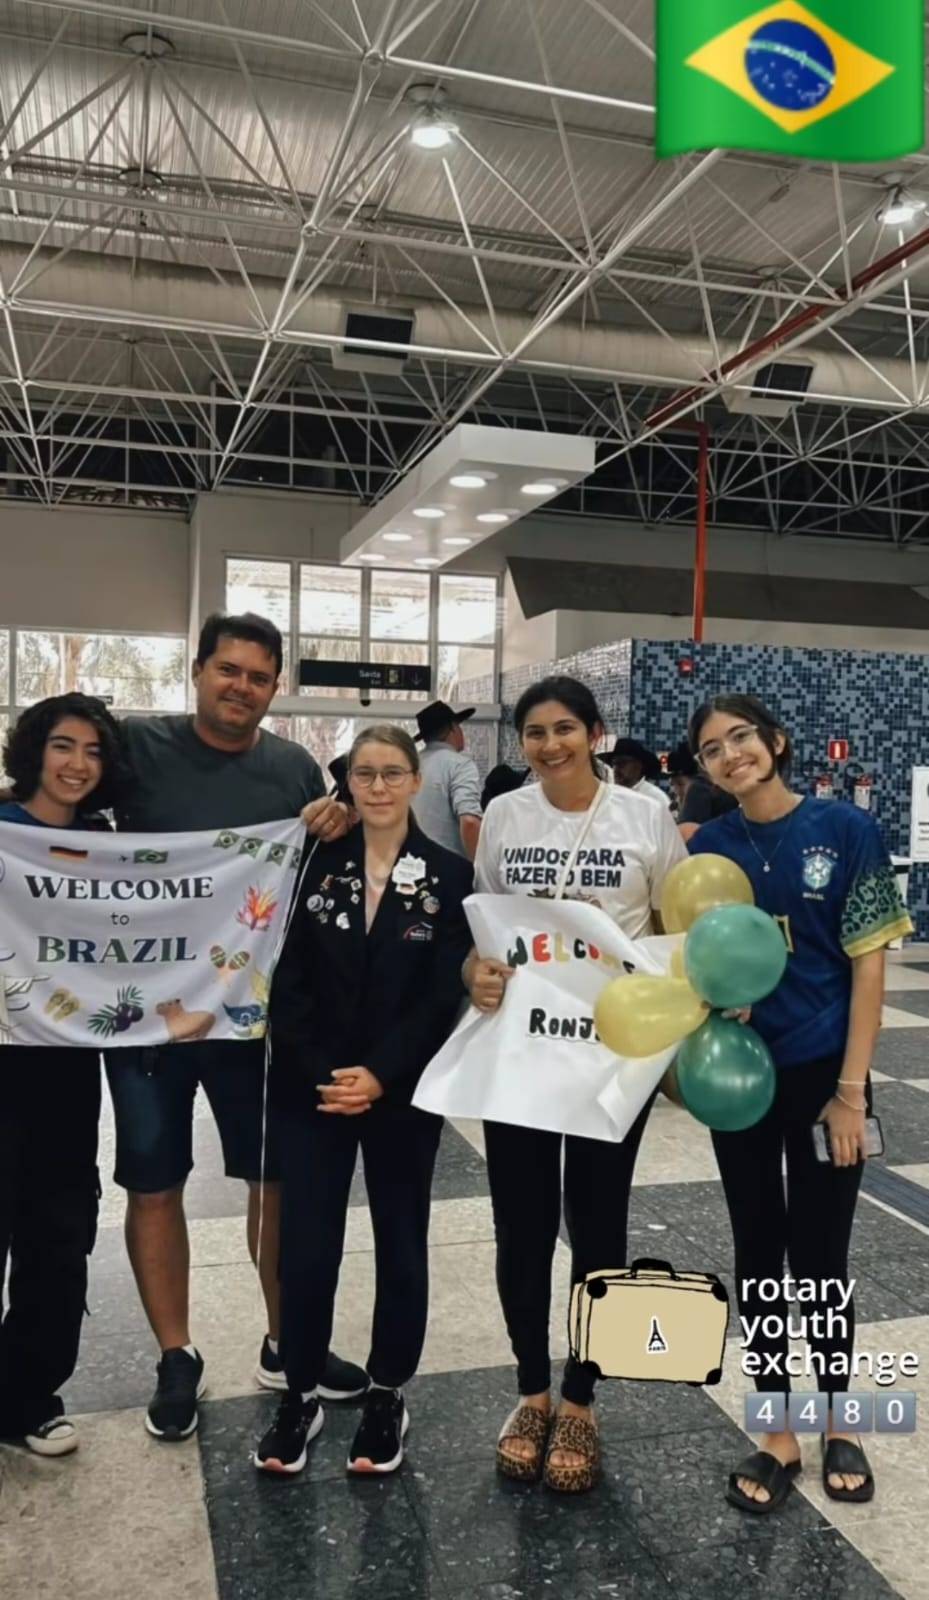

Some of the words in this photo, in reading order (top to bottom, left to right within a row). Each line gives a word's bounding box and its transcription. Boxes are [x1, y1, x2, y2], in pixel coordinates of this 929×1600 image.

[504, 847, 570, 866] UNIDOS
[576, 850, 626, 867] PARA
[24, 875, 213, 900] WELCOME
[506, 867, 556, 884] FAZER
[581, 870, 621, 888] BEM
[110, 911, 130, 926] to
[37, 935, 196, 963] BRAZIL
